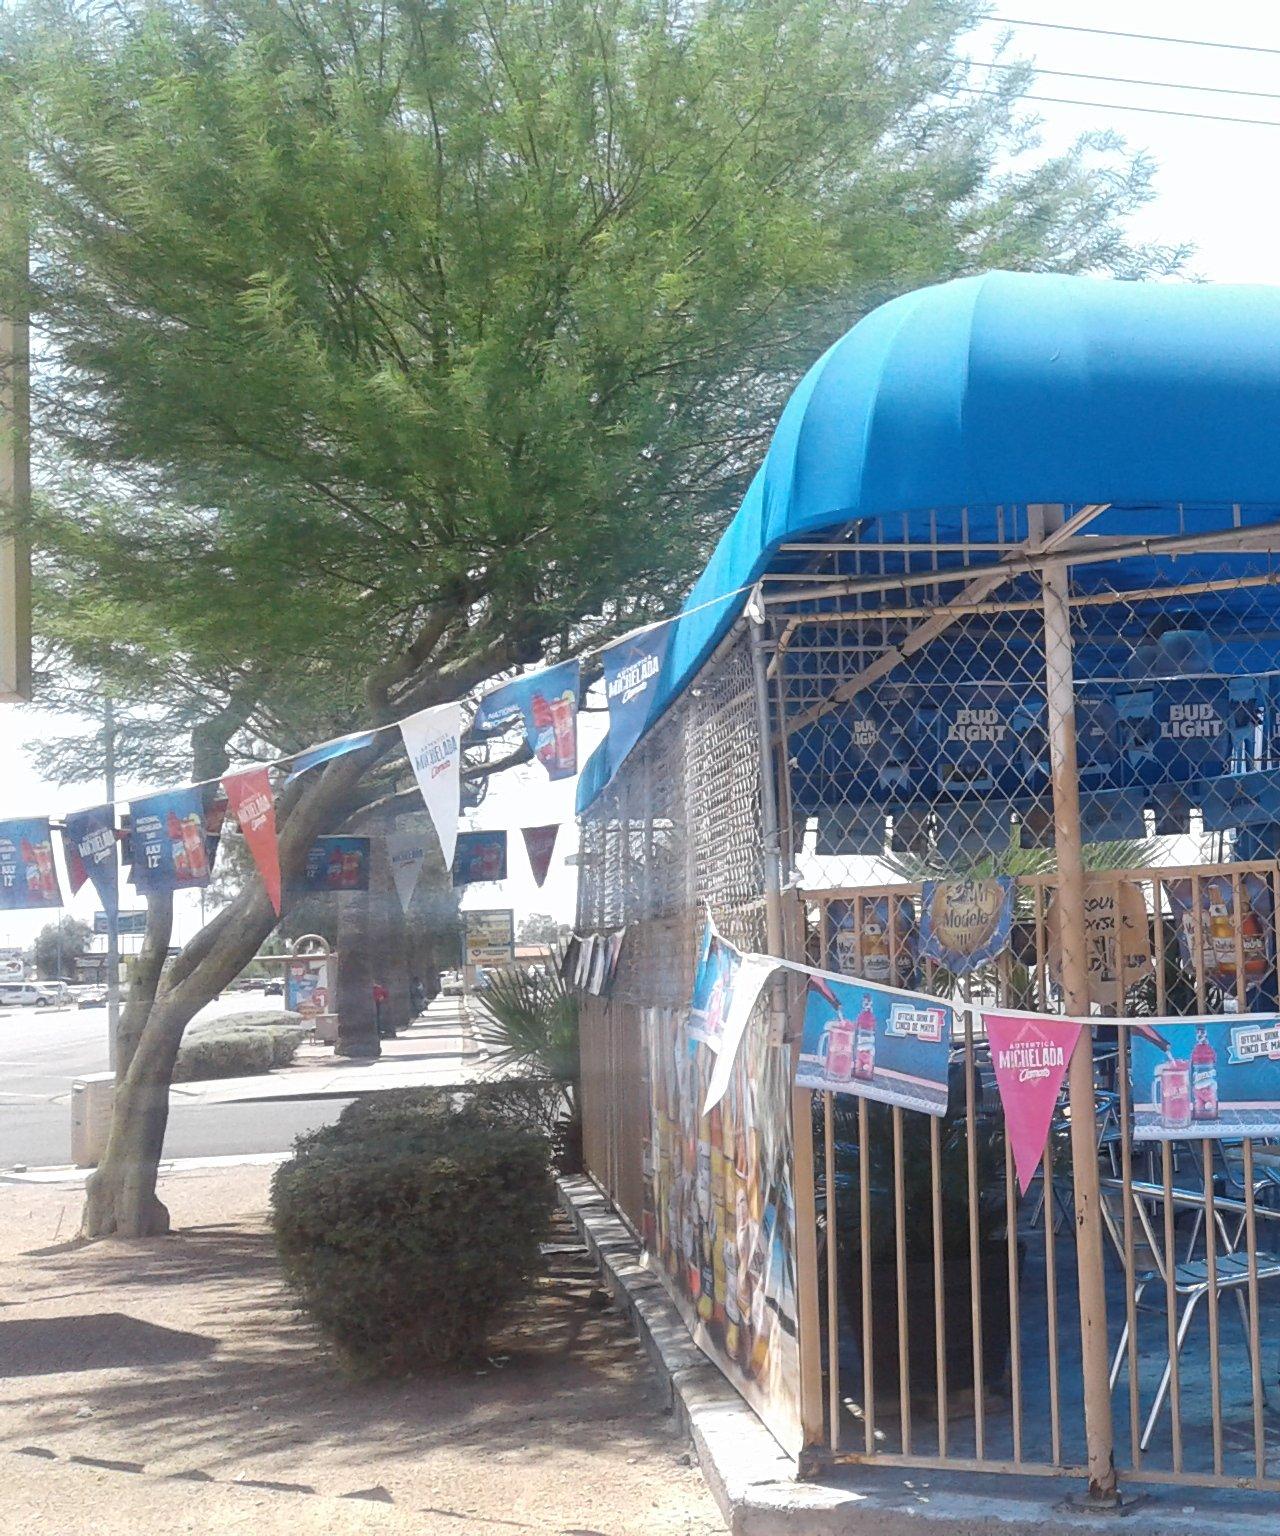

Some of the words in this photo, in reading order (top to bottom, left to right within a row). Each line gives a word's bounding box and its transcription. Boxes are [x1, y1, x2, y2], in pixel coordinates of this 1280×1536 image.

[609, 656, 660, 698] MICHELADA
[956, 709, 999, 725] BUD
[1169, 703, 1214, 721] BUD
[948, 725, 1007, 741] LIGHT
[1160, 720, 1222, 738] LIGHT
[414, 735, 458, 770] MICHELADA
[897, 1012, 915, 1021] OFFICIAL
[895, 1021, 911, 1031] CINCO
[920, 1022, 936, 1033] MAYO
[1240, 1034, 1263, 1045] OFFICIAL
[1240, 1044, 1259, 1055] CINCO
[1260, 1043, 1270, 1052] DE
[999, 1047, 1064, 1068] MICHELADA
[1019, 1067, 1050, 1083] Clamato
